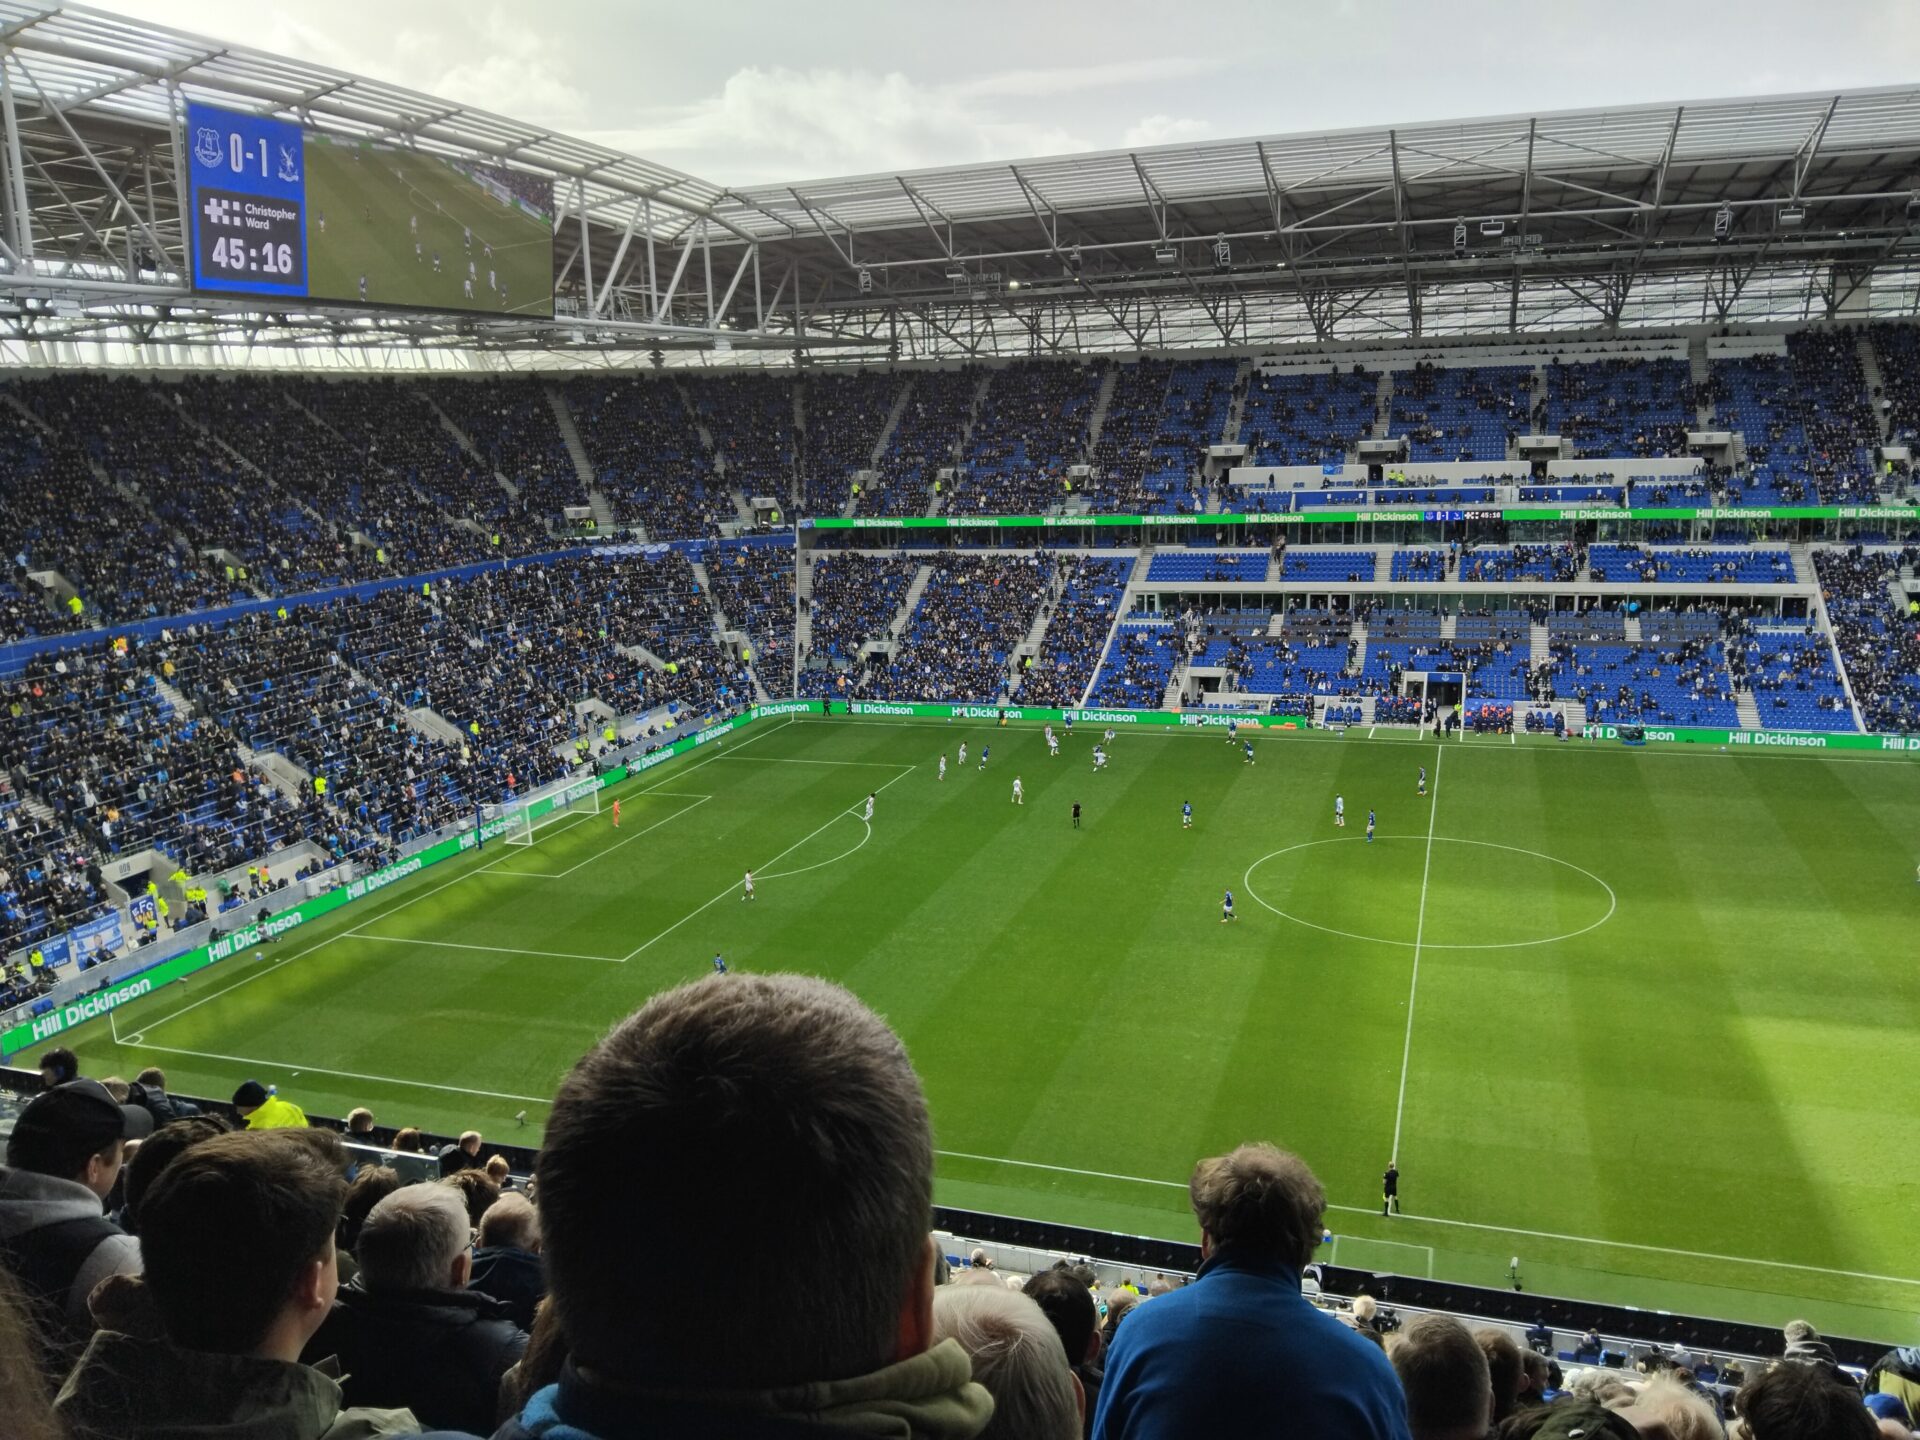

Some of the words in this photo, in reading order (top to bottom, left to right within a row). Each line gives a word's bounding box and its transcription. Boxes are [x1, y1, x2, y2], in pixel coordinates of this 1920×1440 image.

[230, 133, 268, 178] 0-1
[245, 202, 296, 222] Christopher
[246, 217, 270, 231] Ward
[212, 237, 292, 274] 45:16
[1245, 514, 1259, 522] Hill
[1260, 513, 1304, 522] Dickinson
[1356, 512, 1370, 521] Hill
[1373, 512, 1419, 521] Dickinson
[1560, 510, 1576, 519] Hill
[1579, 510, 1632, 519] Dickinson
[1696, 508, 1713, 518] Hill
[1716, 508, 1772, 518] Dickinson
[1838, 508, 1856, 518] Hill
[1859, 508, 1916, 518] Dickinson
[866, 519, 903, 527] Dickinson
[960, 518, 999, 526] Dickinson
[1142, 516, 1154, 524] Hill
[1156, 515, 1197, 524] Dickinson
[760, 703, 809, 715] Dickinson
[864, 704, 913, 715] Dickinson
[1081, 710, 1137, 723] Dickinson
[1729, 732, 1750, 744] Hill
[1754, 733, 1826, 747] Dickinson
[1882, 737, 1905, 749] Hill
[641, 748, 674, 770] Dickinson
[346, 879, 366, 901] Hill
[367, 858, 422, 891] Dickinson
[208, 938, 231, 962] Hill
[32, 1013, 63, 1041] Hill
[65, 978, 151, 1026] Dickinson
